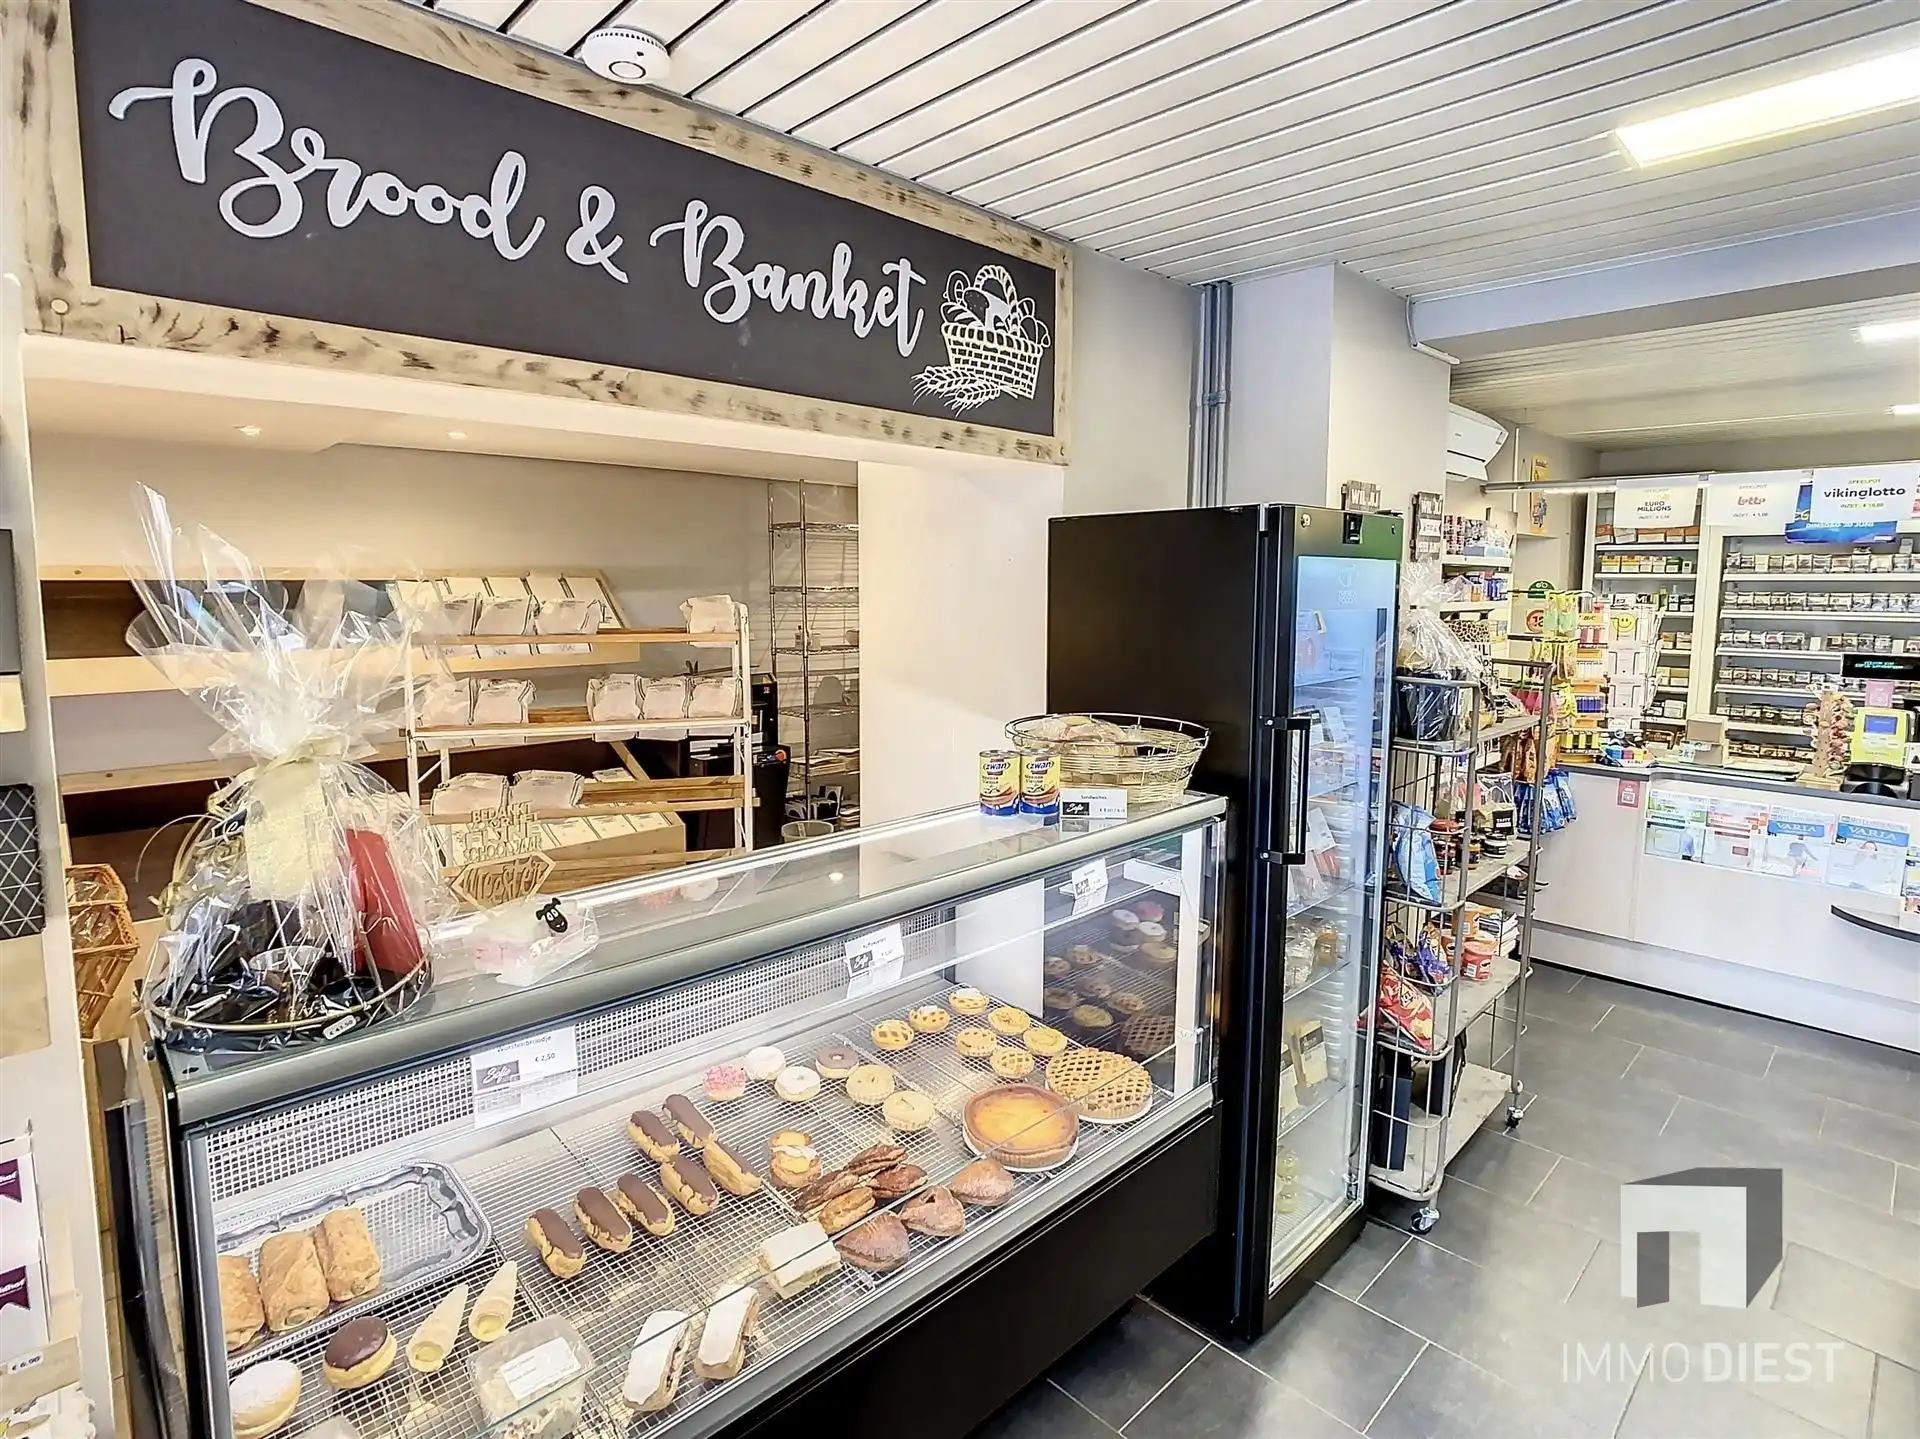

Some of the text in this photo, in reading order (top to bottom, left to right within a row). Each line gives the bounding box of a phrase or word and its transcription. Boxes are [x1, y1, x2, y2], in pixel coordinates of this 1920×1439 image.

[108, 56, 928, 358] Brood & Banket
[1823, 487, 1906, 500] vikinglotto
[985, 762, 1007, 770] zwan
[1029, 761, 1052, 769] zwan
[1776, 822, 1818, 833] VARIA
[1848, 823, 1898, 841] VARIA
